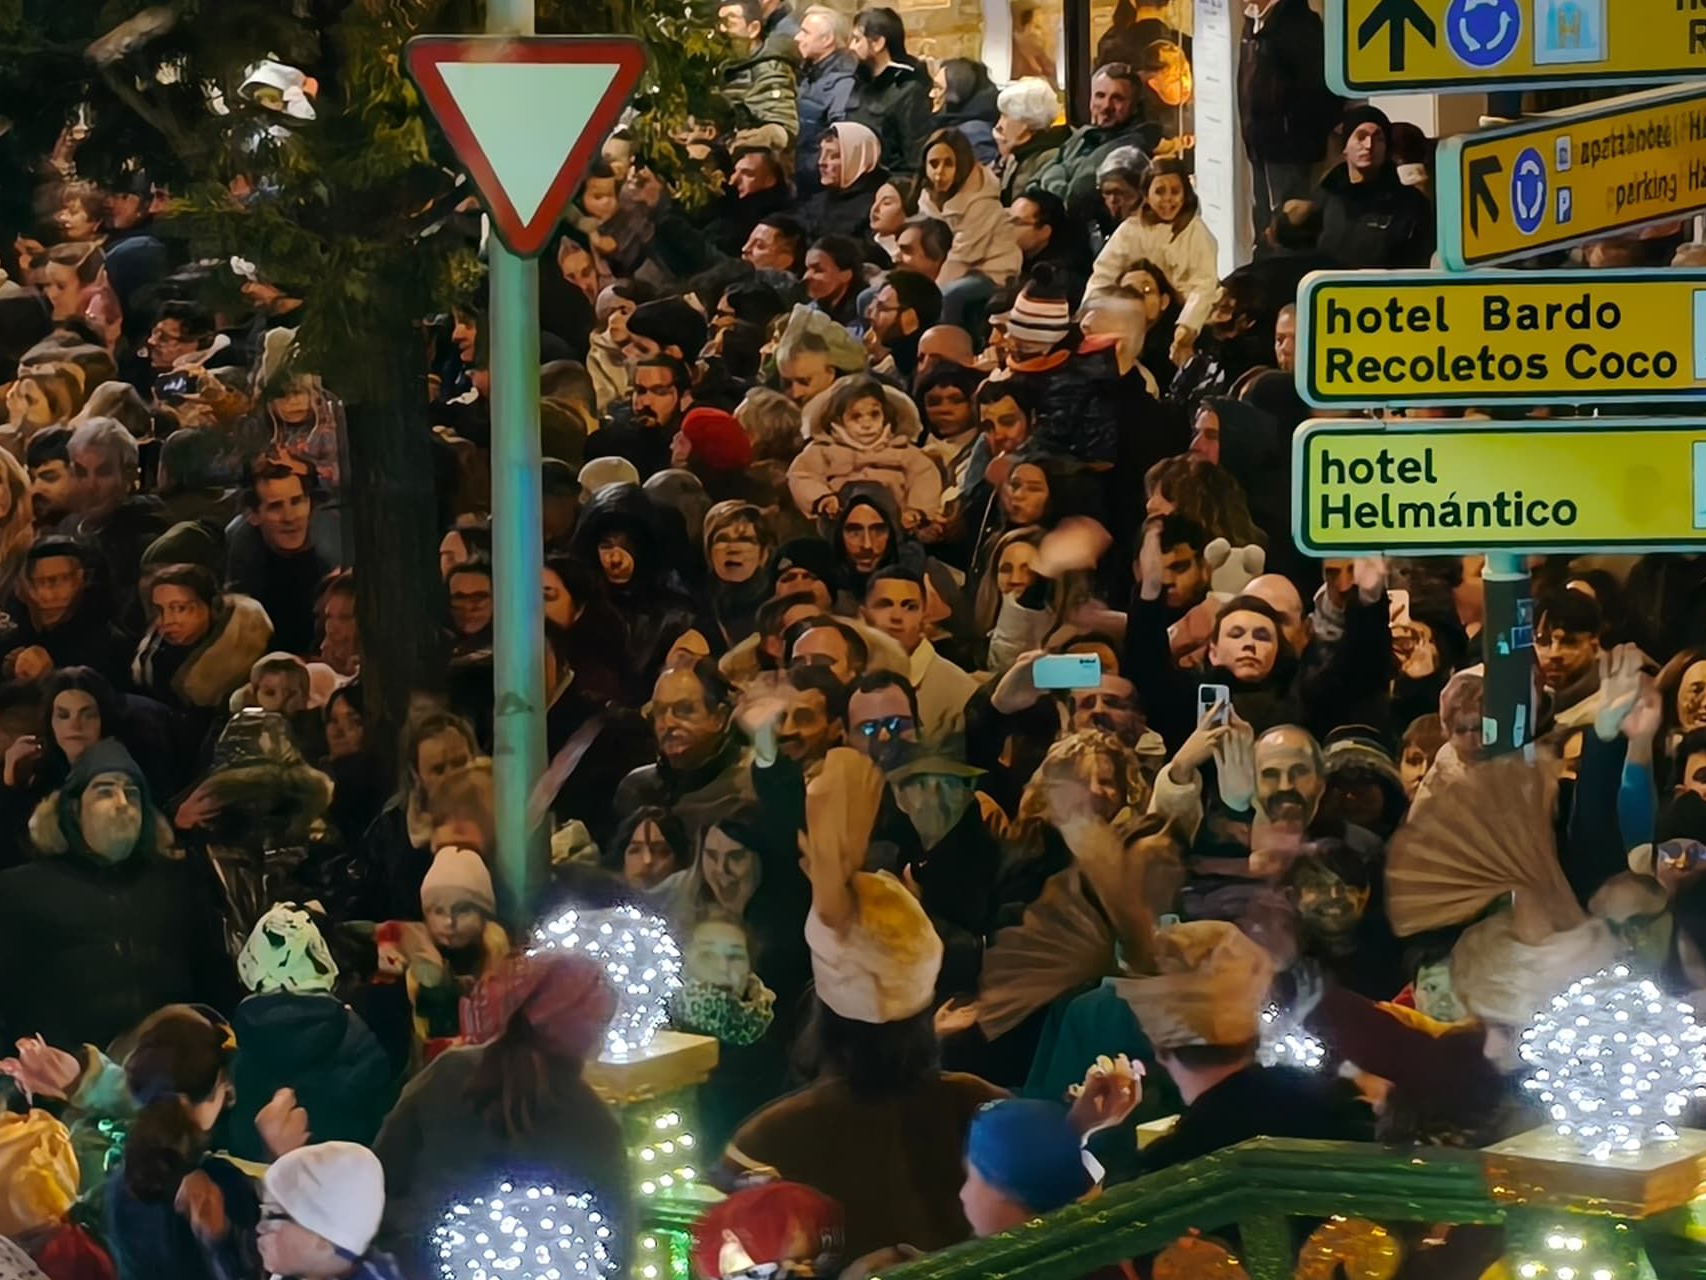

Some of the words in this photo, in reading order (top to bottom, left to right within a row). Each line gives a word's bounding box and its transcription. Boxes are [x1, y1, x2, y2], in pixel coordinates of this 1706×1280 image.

[1613, 168, 1678, 214] parking
[1326, 296, 1449, 334] hotel
[1482, 293, 1622, 332] Bardo
[1326, 345, 1549, 384] Recoletos
[1565, 343, 1678, 380] Coco
[1321, 448, 1438, 485] hotel
[1320, 491, 1578, 529] Helmántico
